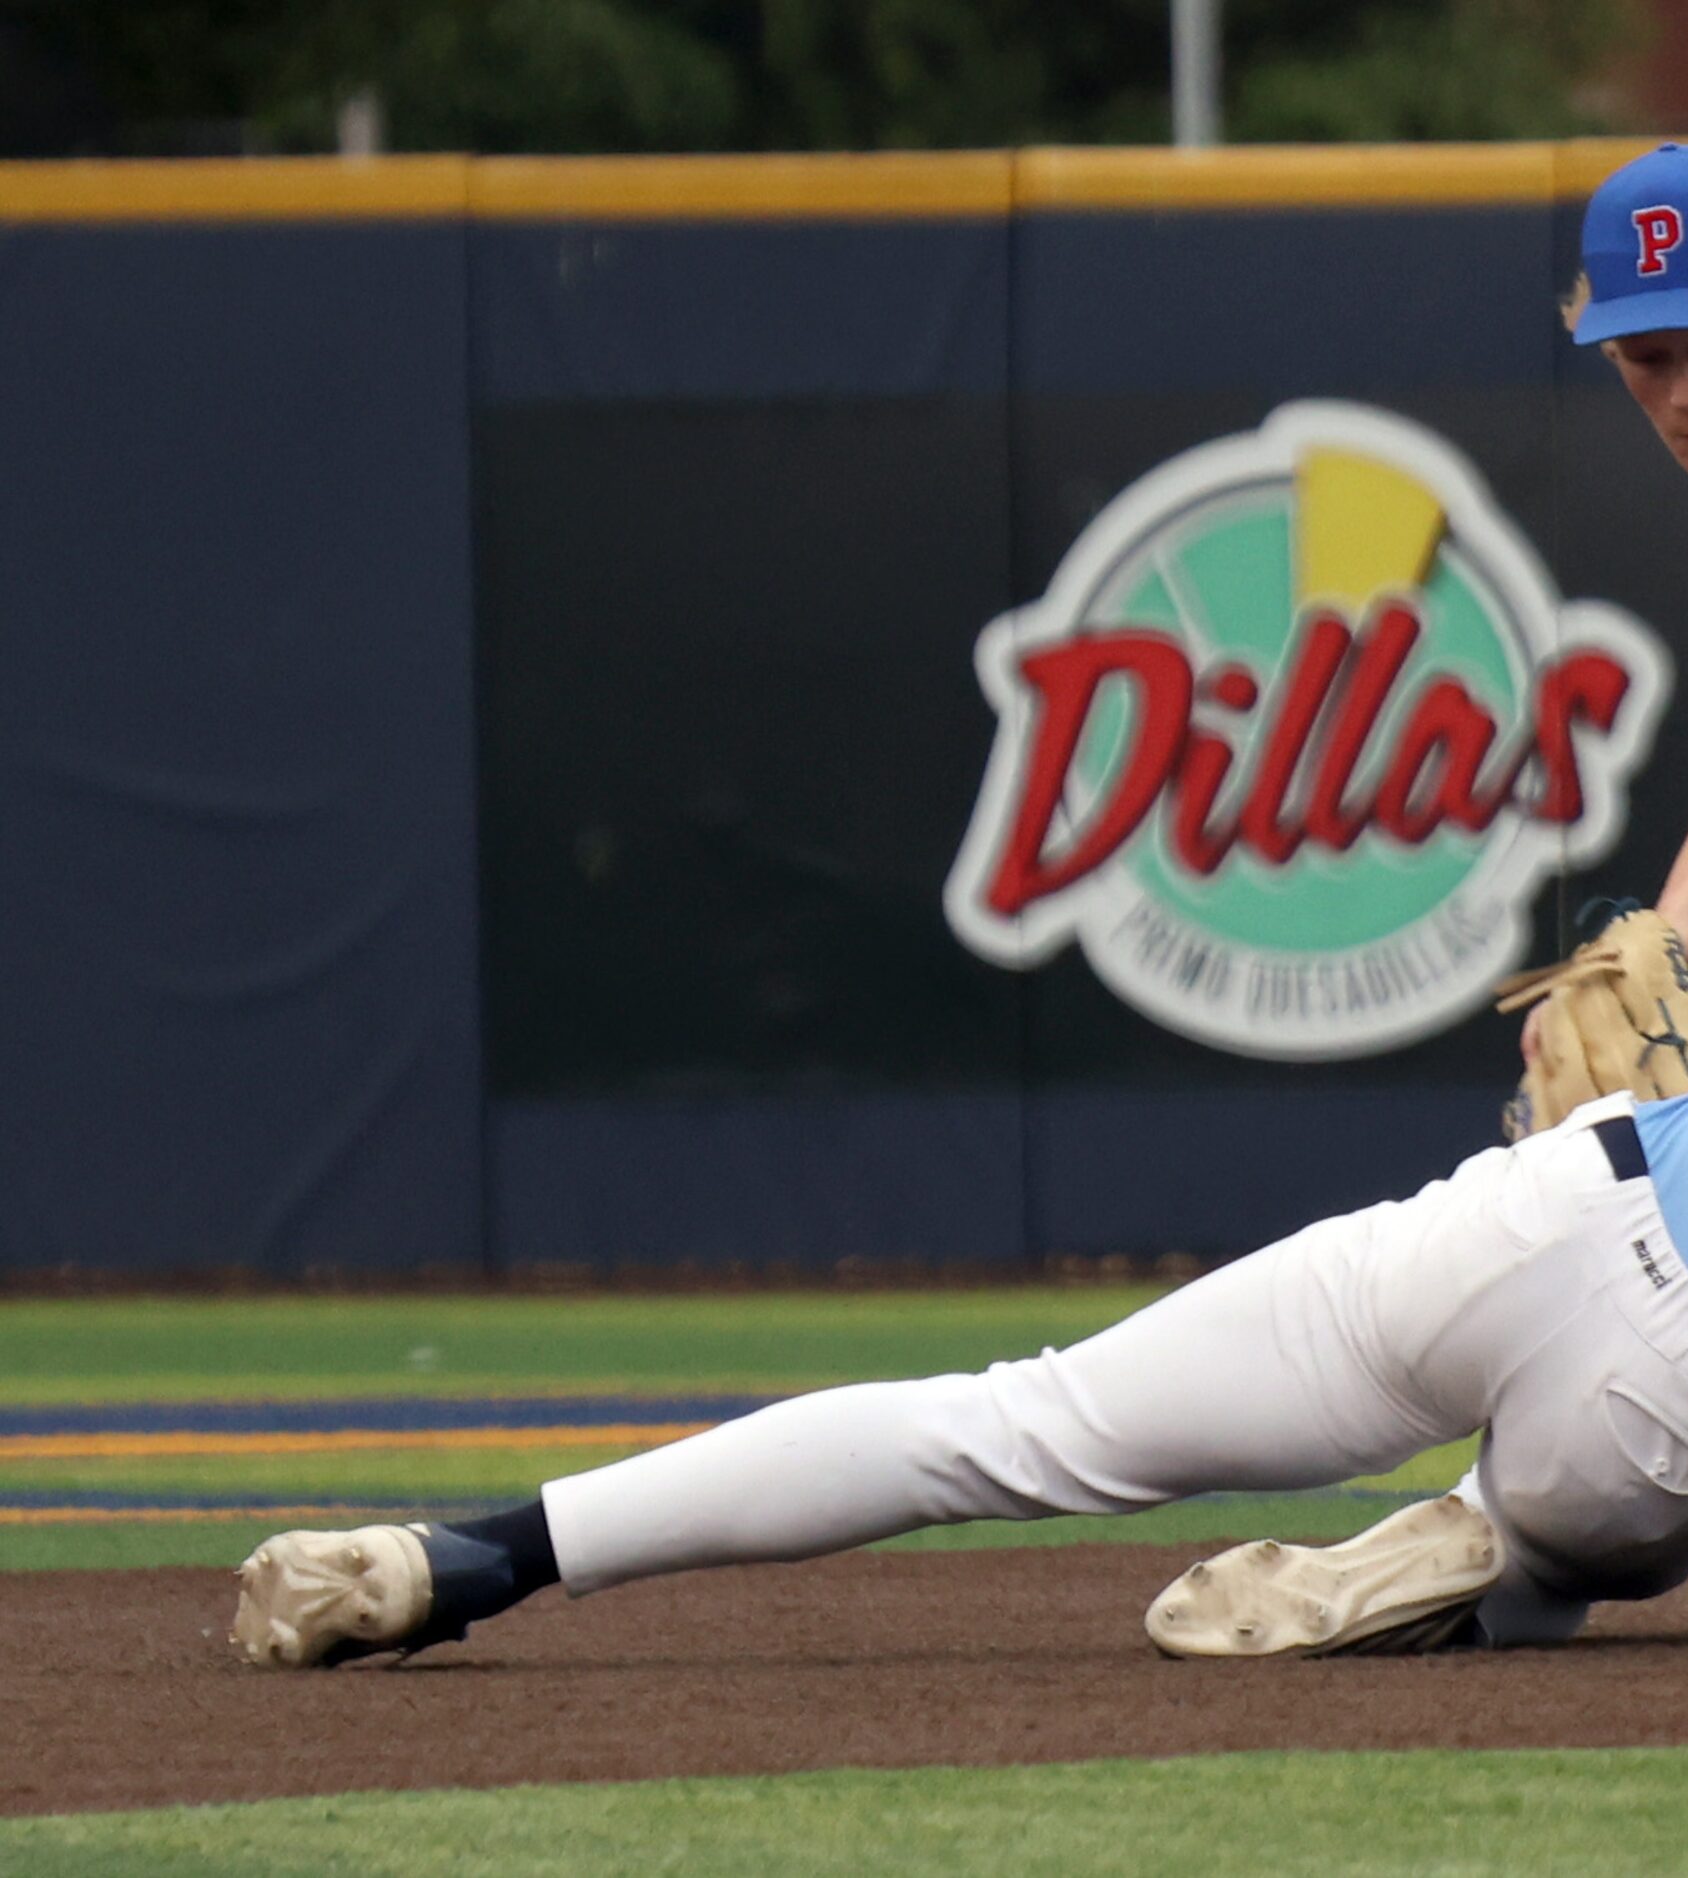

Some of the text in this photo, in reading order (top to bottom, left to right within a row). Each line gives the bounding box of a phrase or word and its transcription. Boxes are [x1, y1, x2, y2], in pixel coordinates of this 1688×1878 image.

[1632, 205, 1683, 278] P
[985, 605, 1630, 915] Dillas
[1108, 893, 1492, 1016] PRIMO QUESADILLAS
